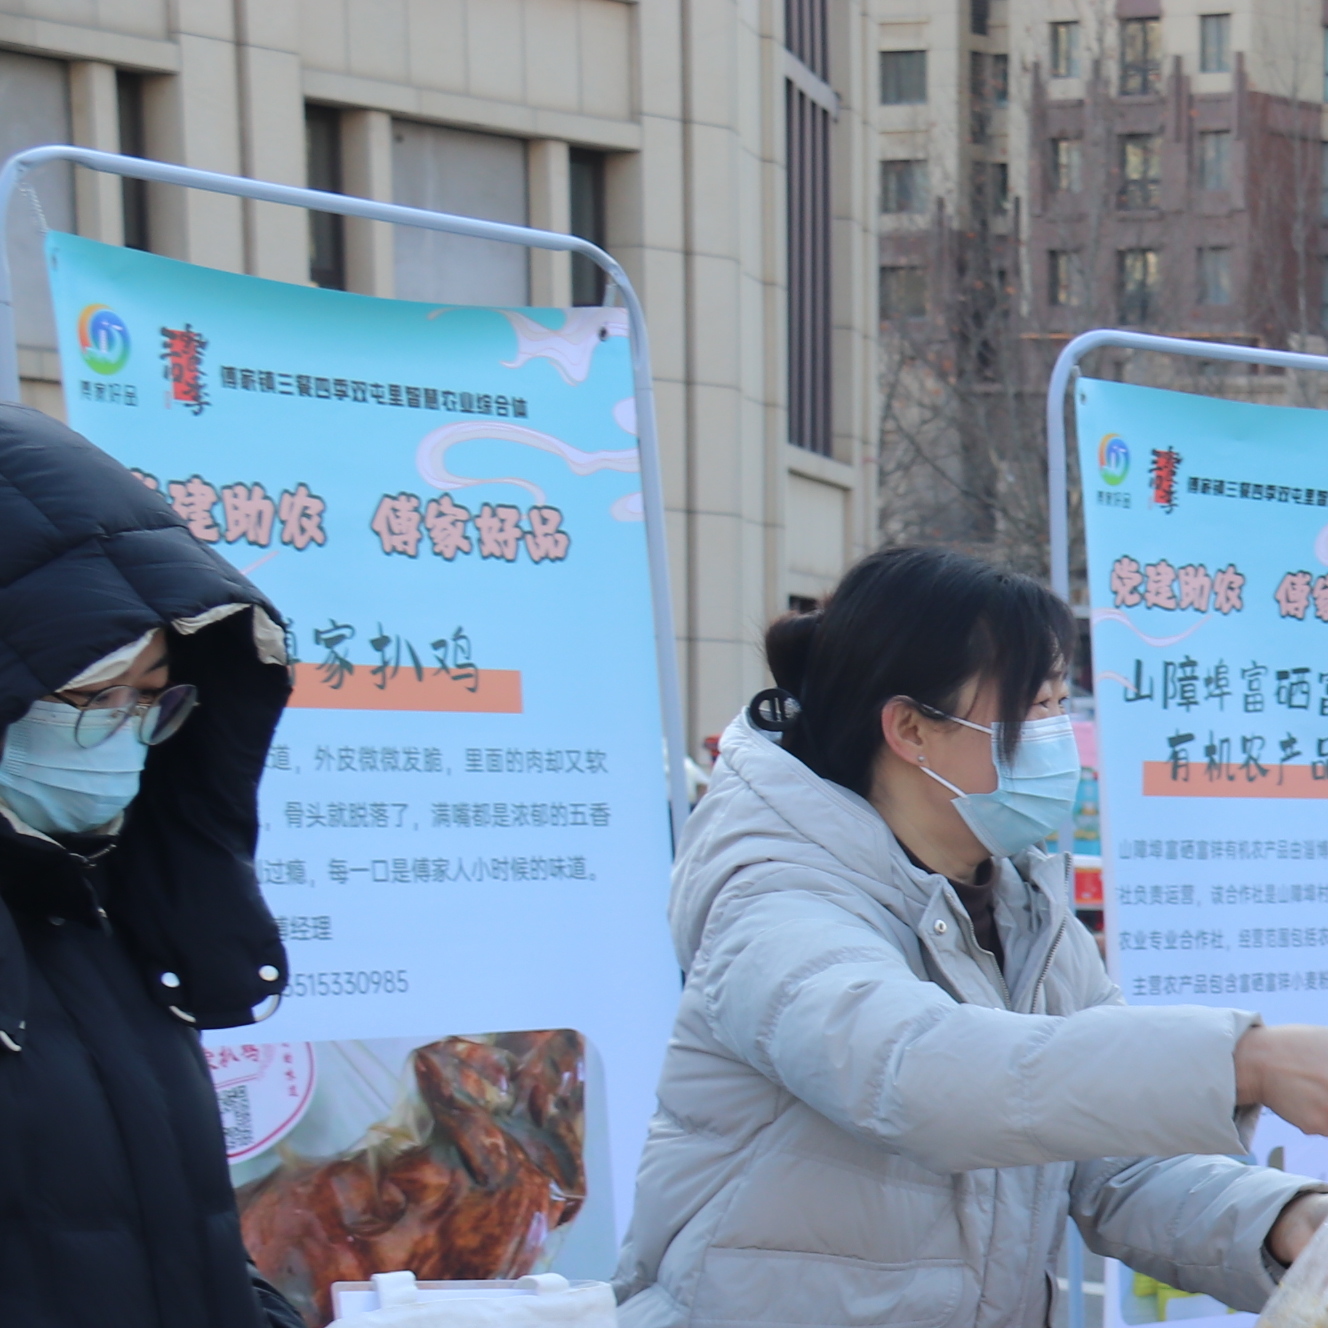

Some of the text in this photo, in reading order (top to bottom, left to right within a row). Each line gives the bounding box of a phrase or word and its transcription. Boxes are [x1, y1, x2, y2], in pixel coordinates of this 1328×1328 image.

[220, 365, 528, 418] 傅家镇三餐四季双屯里智慧农业综合体
[128, 469, 570, 561] 建助农 傅家好品
[1111, 555, 1246, 615] 党建助农
[256, 857, 600, 887] 过瘾，每一口是傅家人小时候的味道。
